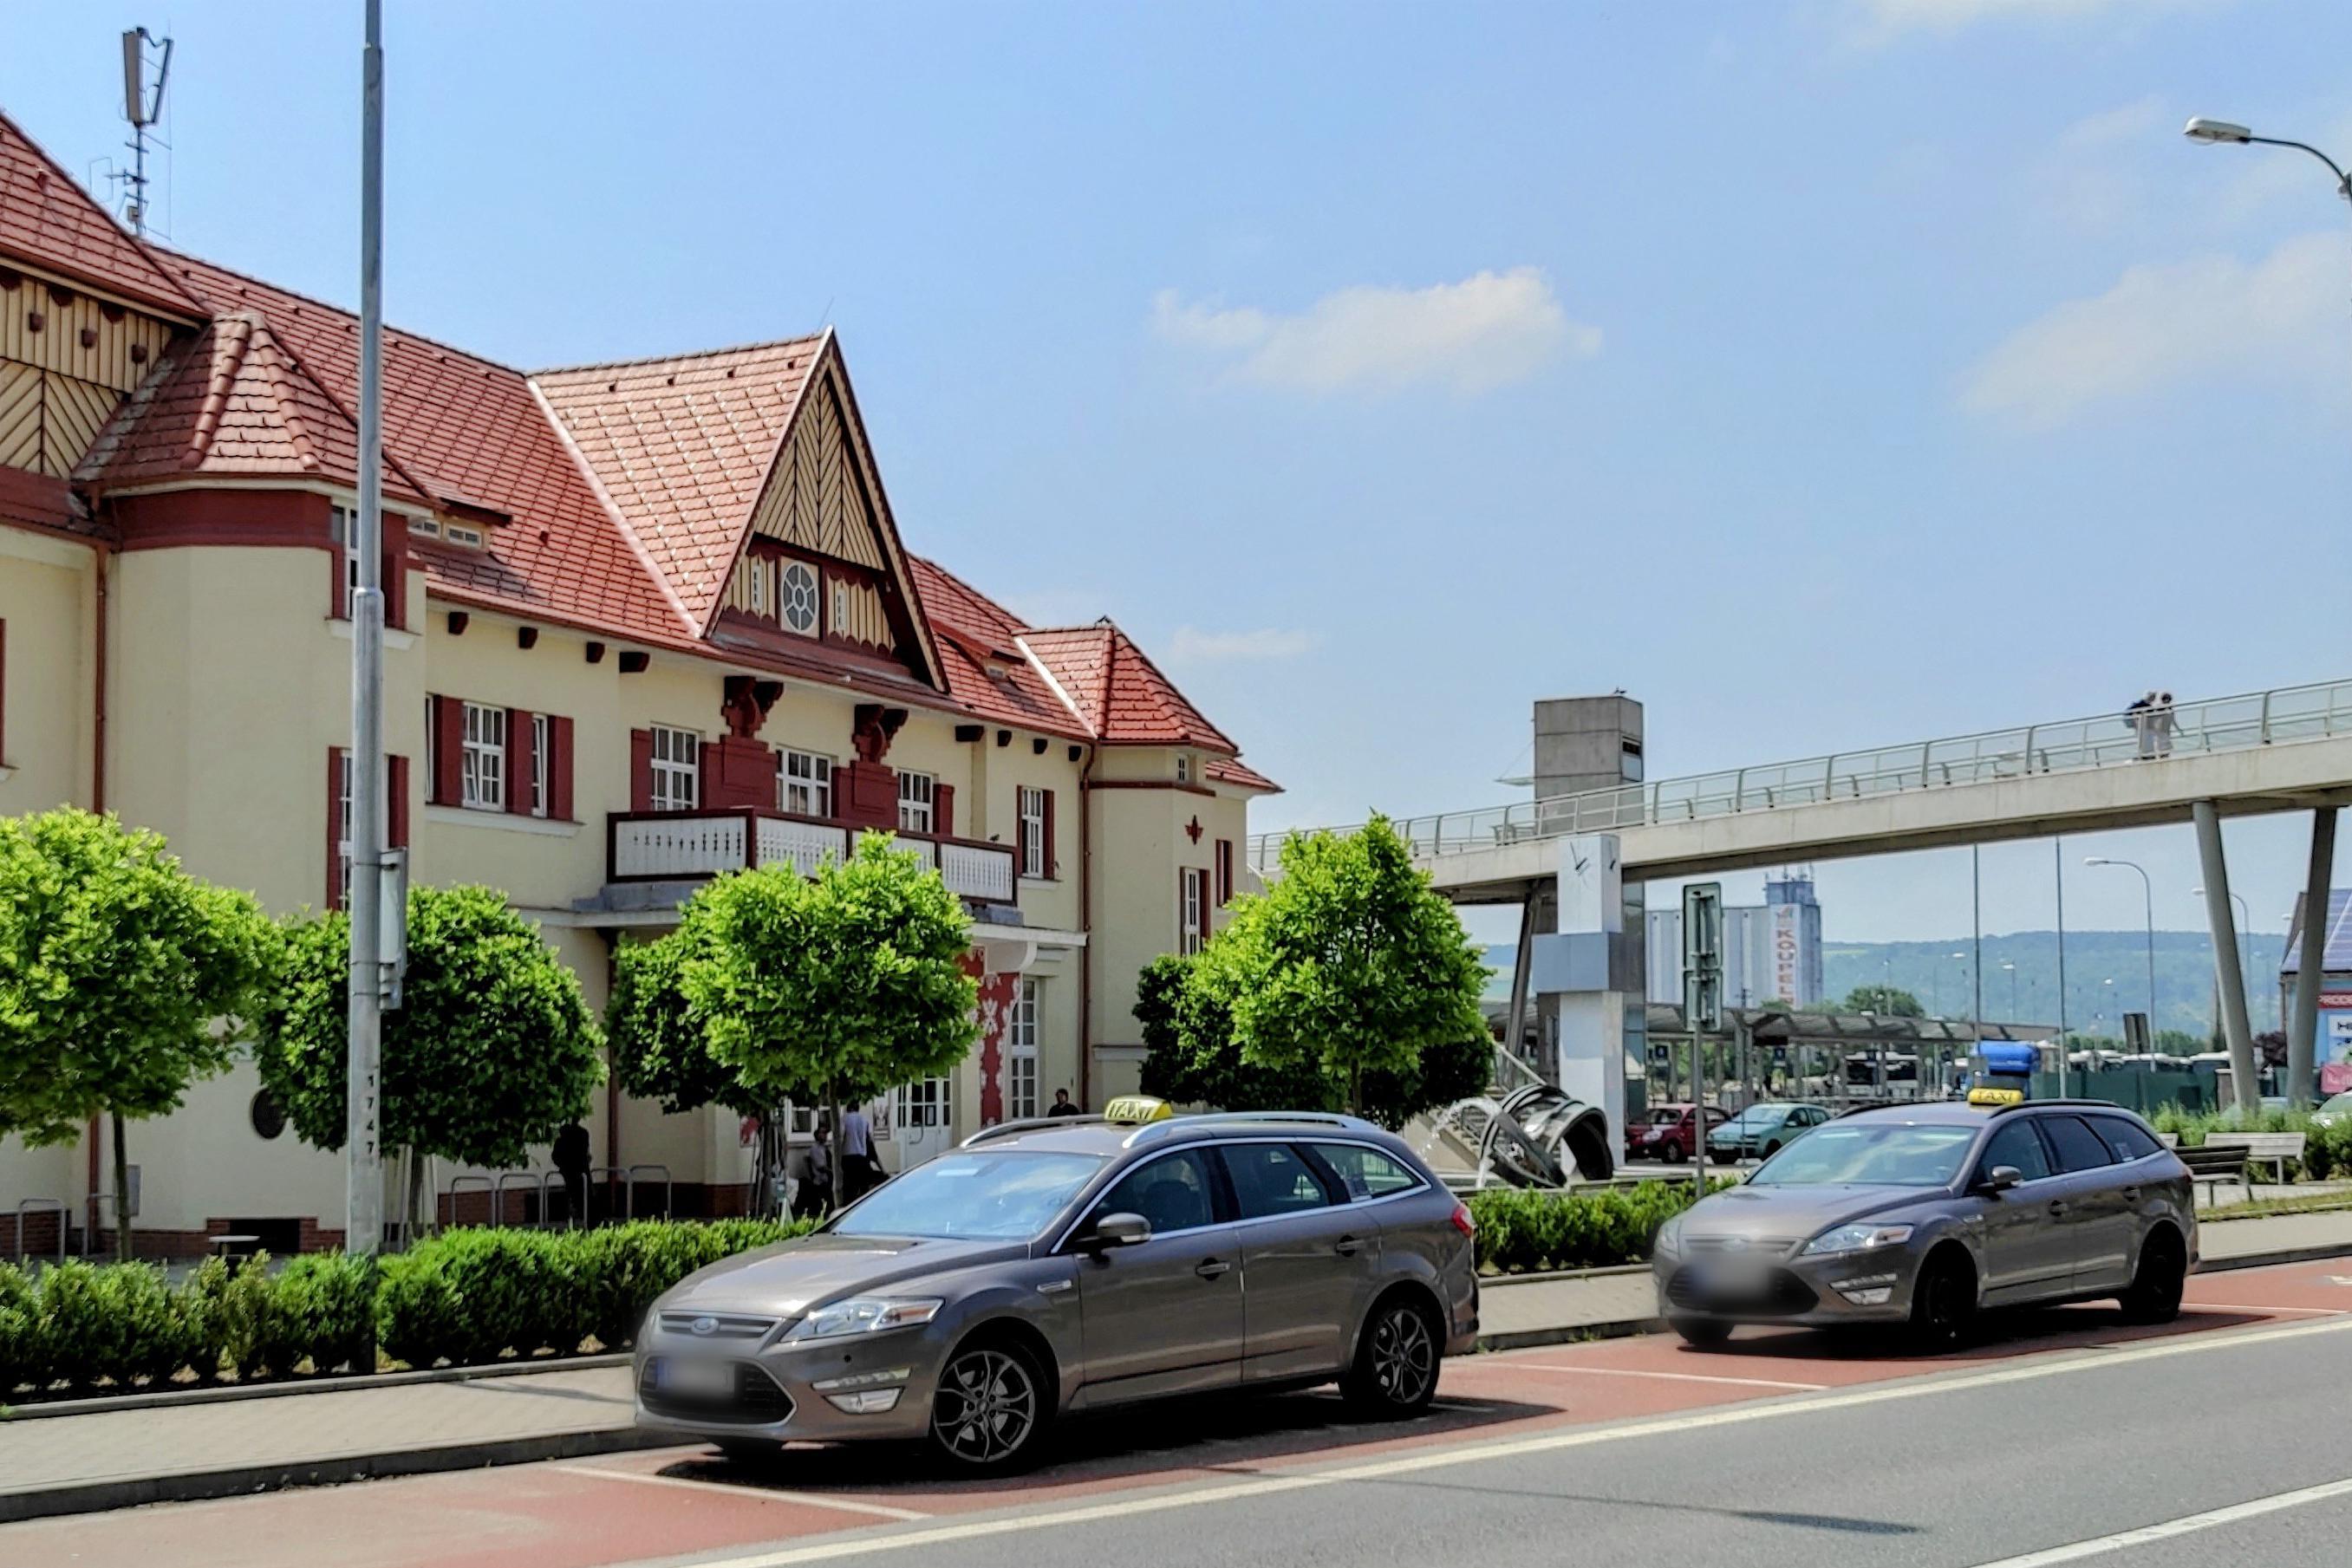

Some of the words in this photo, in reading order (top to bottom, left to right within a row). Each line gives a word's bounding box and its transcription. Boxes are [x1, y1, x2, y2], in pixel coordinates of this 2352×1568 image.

[1973, 1090, 2012, 1102] TAXI
[366, 1075, 375, 1155] 1747
[1109, 1100, 1152, 1120] TAXI
